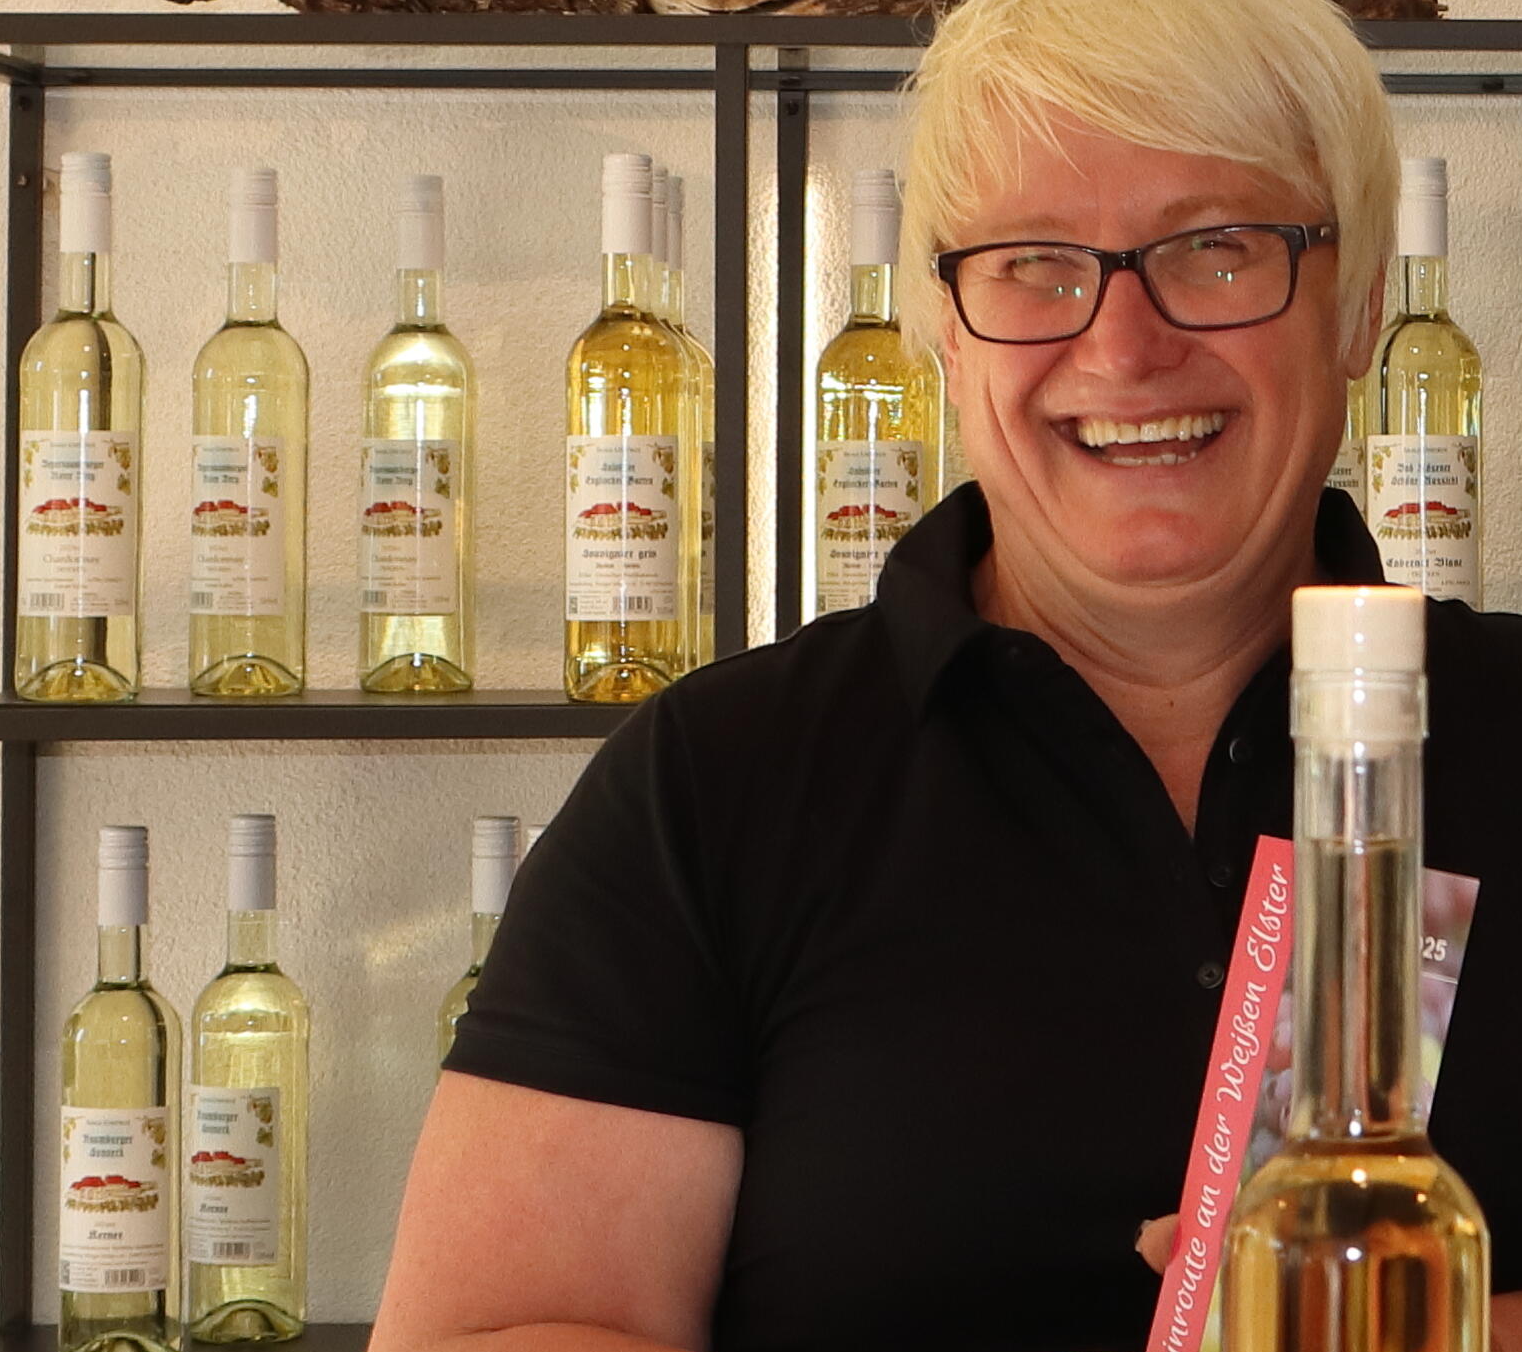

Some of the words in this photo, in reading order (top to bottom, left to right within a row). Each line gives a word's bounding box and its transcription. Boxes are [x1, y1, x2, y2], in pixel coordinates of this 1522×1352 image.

[1247, 862, 1290, 972] Elster
[1216, 978, 1268, 1103] Weißen
[1199, 1110, 1232, 1176] der
[1190, 1179, 1222, 1224] an
